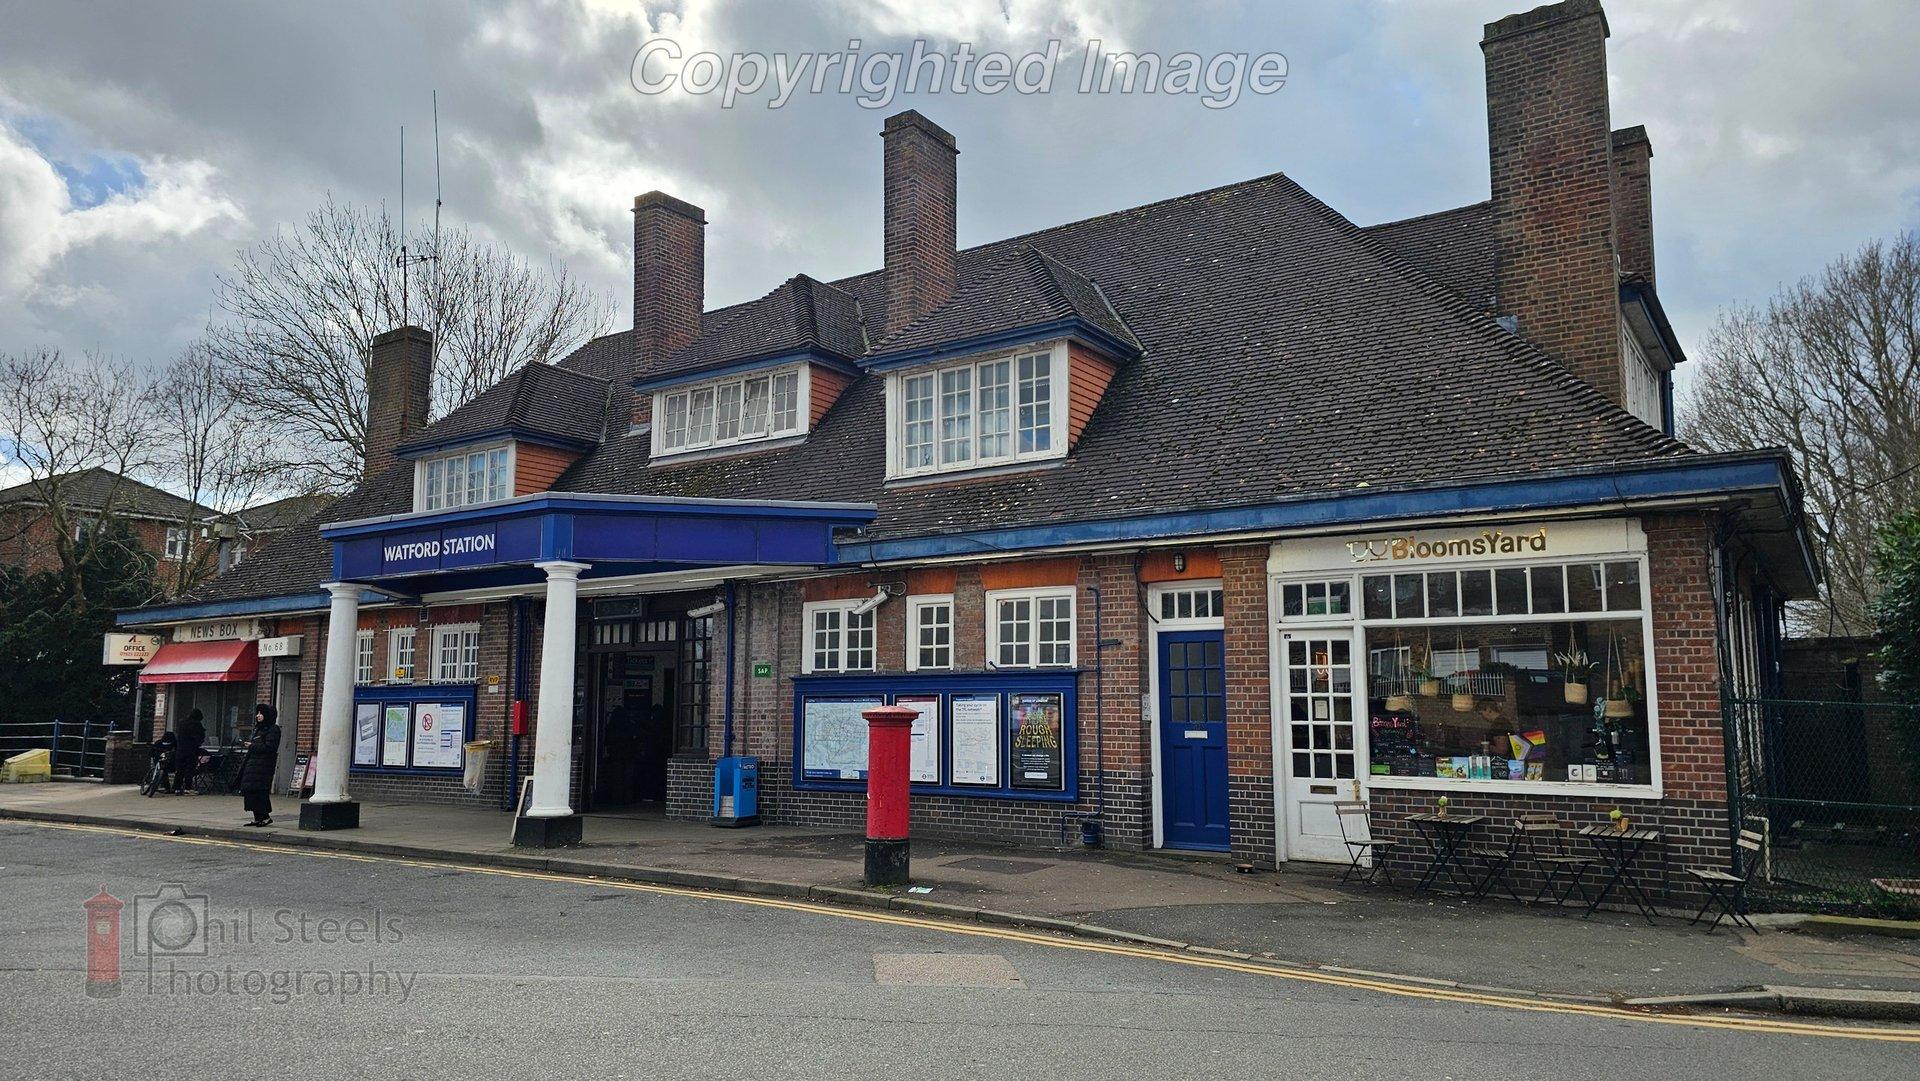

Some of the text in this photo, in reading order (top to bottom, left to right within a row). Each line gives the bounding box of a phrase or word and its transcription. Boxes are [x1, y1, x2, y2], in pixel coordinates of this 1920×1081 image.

[384, 534, 495, 562] WATFORD STATION
[1391, 526, 1547, 560] BloomsYard
[190, 623, 238, 639] NEWS BOX
[1019, 724, 1053, 736] ROUGH
[1015, 735, 1058, 748] SLEEPING
